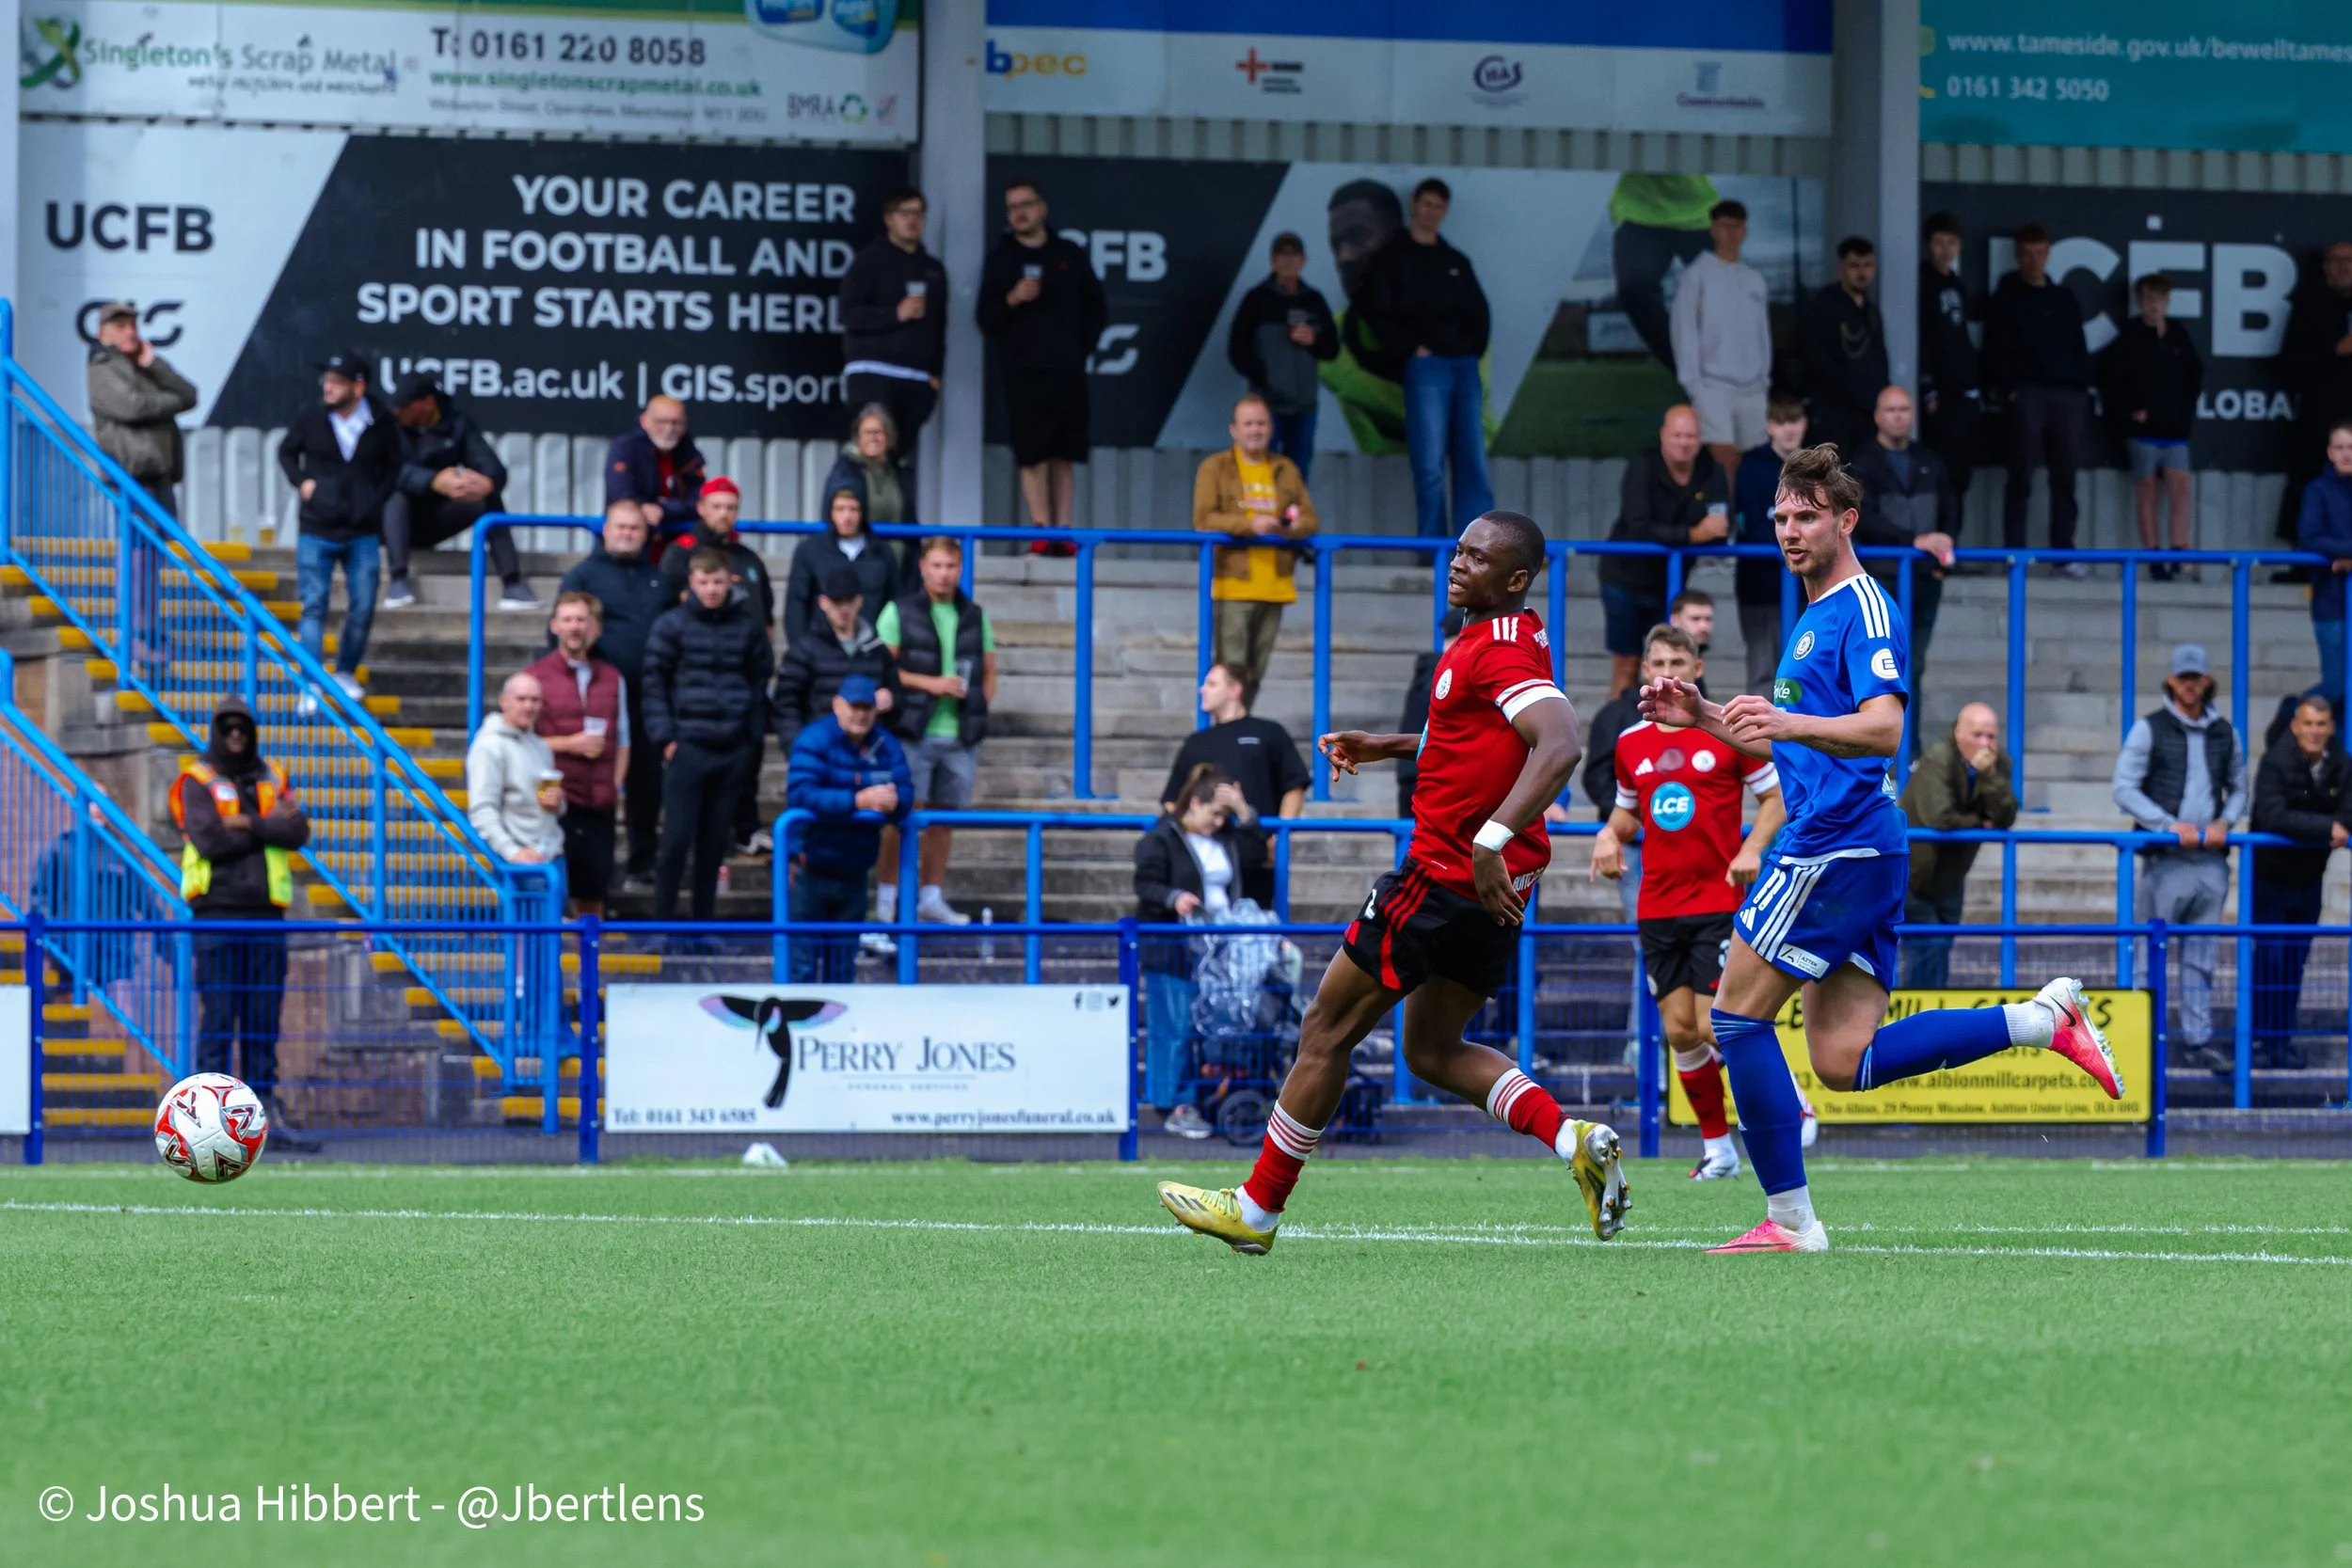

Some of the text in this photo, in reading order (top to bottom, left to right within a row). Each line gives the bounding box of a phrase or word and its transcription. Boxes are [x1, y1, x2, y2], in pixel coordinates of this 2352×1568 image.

[83, 40, 397, 76] Singleton's Scrap Metal
[470, 28, 545, 60] 0161
[559, 34, 617, 64] 220
[627, 36, 707, 67] 8058
[429, 68, 762, 98] www.singletonscrapmetal.co.uk
[1947, 75, 2110, 103] 0161 342 5050
[513, 174, 857, 223] YOUR CAREER
[44, 201, 215, 253] UCFB
[416, 228, 855, 278] IN FOOTBALL AND
[357, 282, 522, 327] SPORT
[532, 287, 714, 332] STARTS
[2196, 388, 2298, 420] LOBA
[1652, 796, 1690, 816] LCE
[797, 1035, 1017, 1072] PERRY JONES
[645, 1107, 682, 1124] 0161
[891, 1108, 1116, 1128] www.perryjonesfuneral.co.uk
